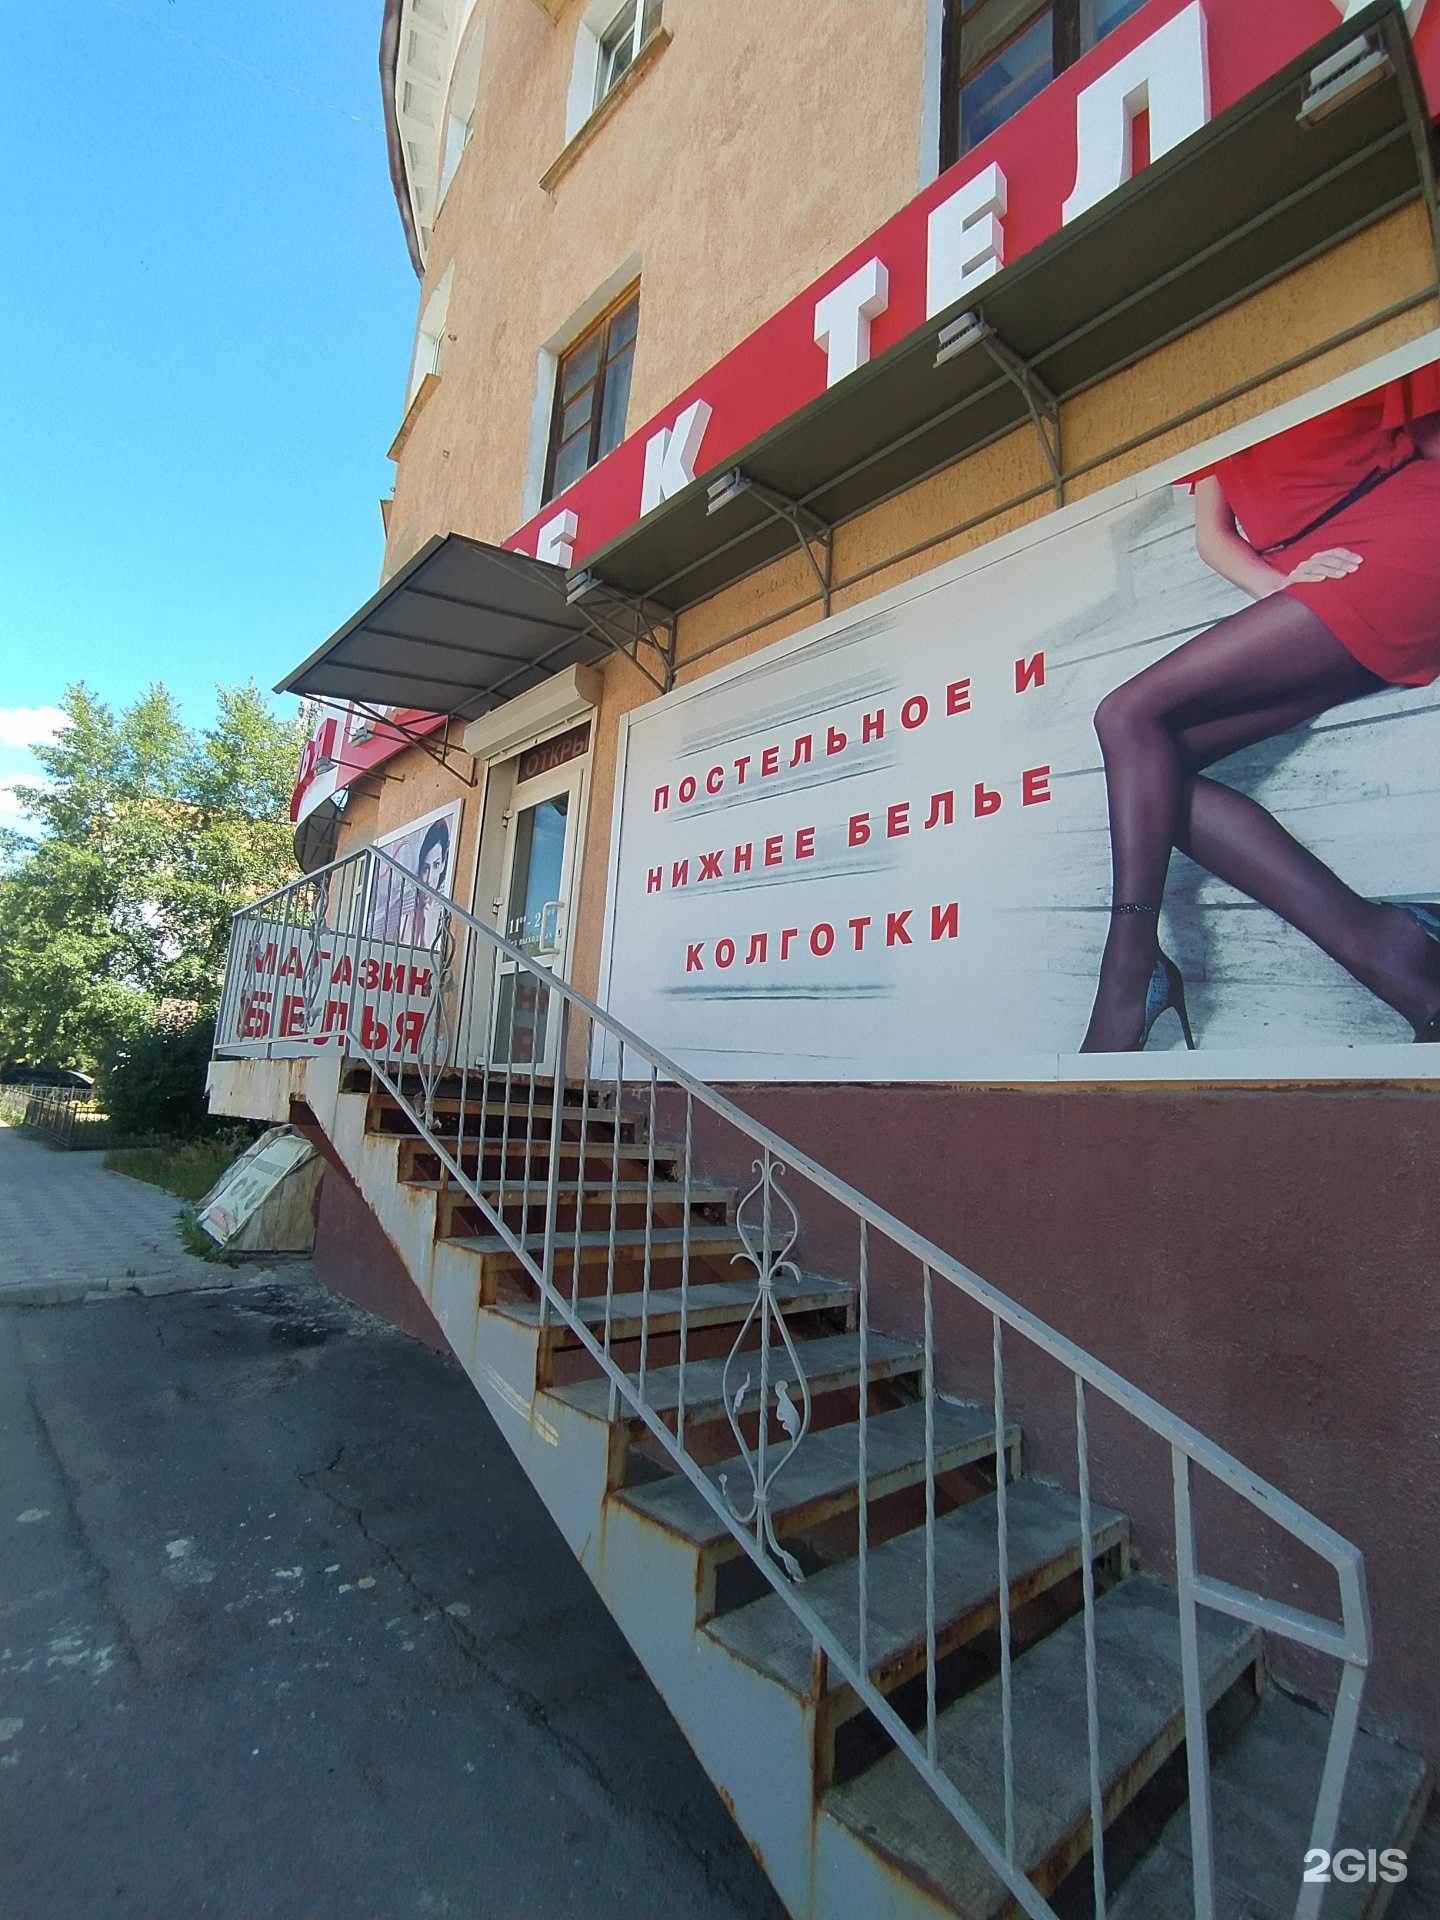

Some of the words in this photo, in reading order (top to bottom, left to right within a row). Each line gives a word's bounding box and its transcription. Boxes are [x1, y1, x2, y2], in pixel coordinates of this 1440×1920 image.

[653, 678, 972, 813] ПОСТЕЛЬНОЕ
[1014, 651, 1046, 694] И
[646, 827, 816, 894] НИЖНЕЕ
[848, 765, 1052, 847] БЕЛЬЕ
[244, 943, 431, 997] МАГАЗИН
[685, 902, 960, 972] КОЛГОТКИ
[237, 991, 425, 1054] БЕЛЬЯ
